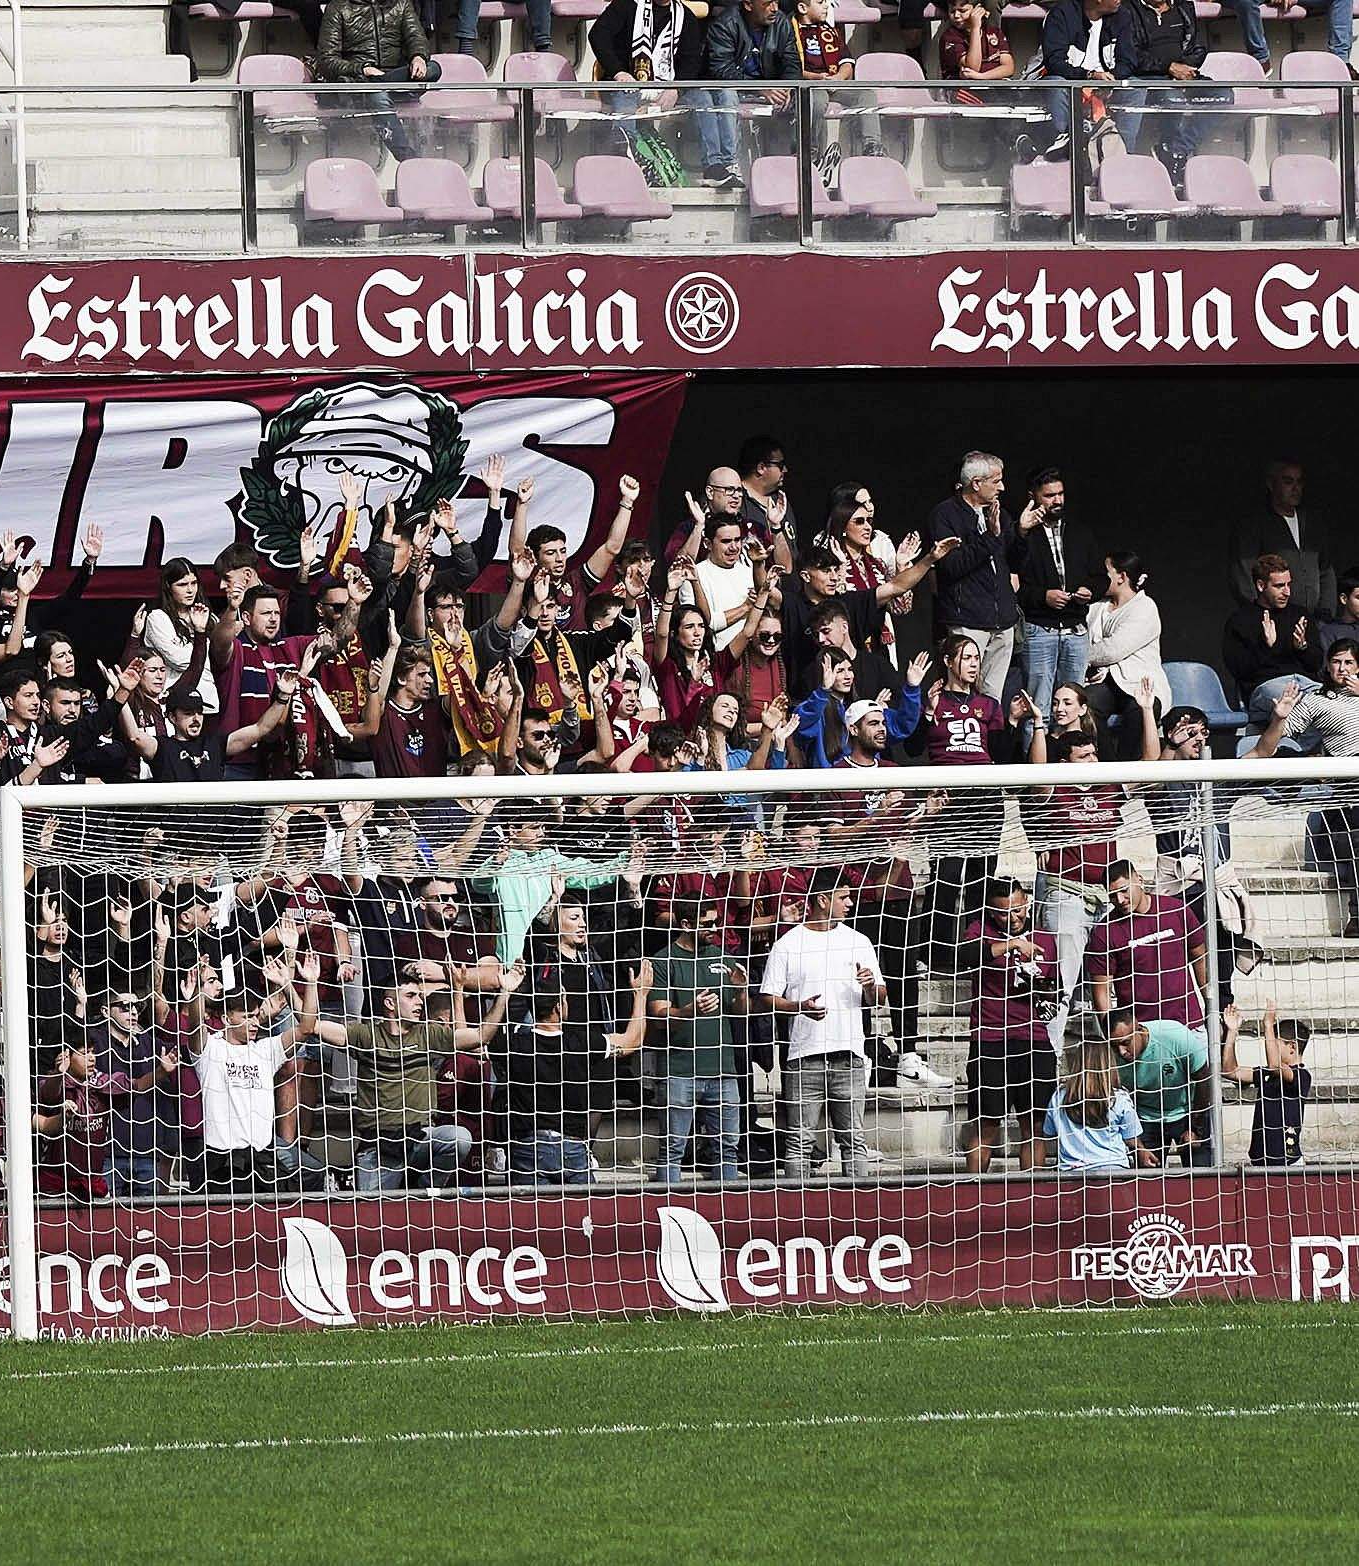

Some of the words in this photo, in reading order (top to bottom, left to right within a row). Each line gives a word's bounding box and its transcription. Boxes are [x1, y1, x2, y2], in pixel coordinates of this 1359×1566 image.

[21, 274, 339, 361] Estrella
[357, 267, 643, 357] Galicia
[931, 267, 1237, 352] Estrella
[1127, 1213, 1186, 1233] CONSERVAS
[369, 1245, 548, 1309] ence
[736, 1234, 912, 1297] ence
[1071, 1243, 1258, 1281] PESCAMAR
